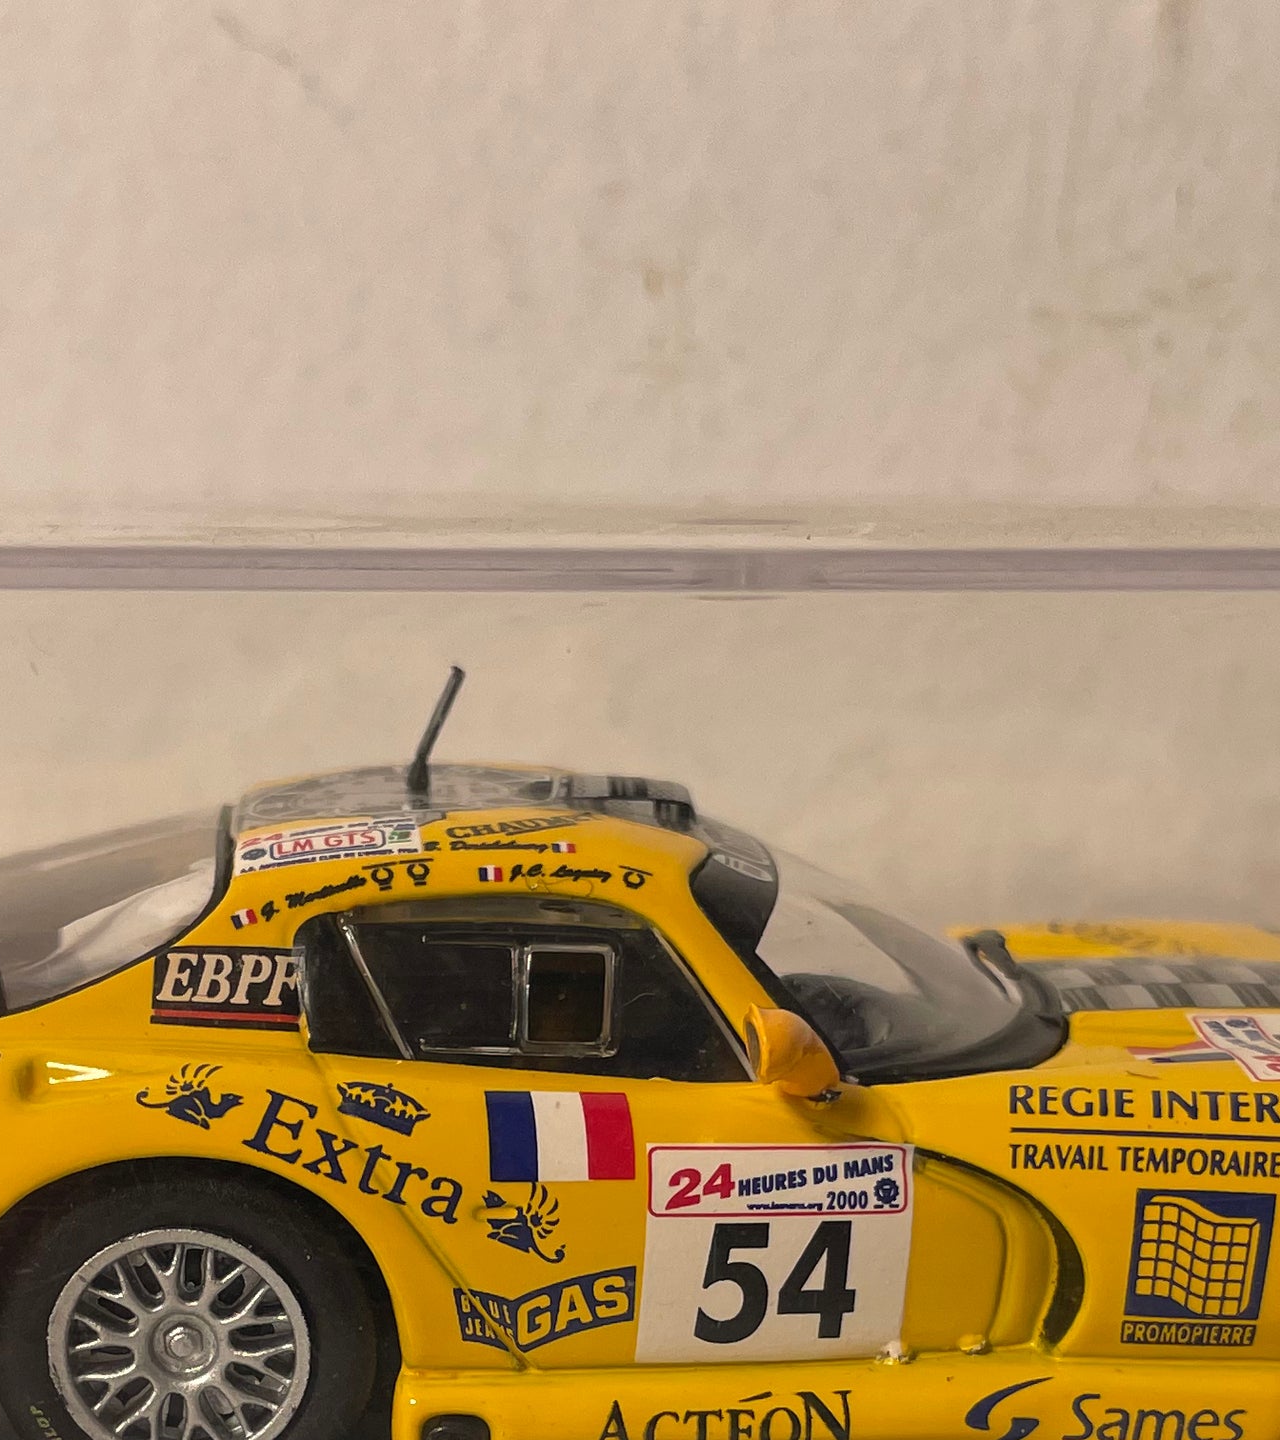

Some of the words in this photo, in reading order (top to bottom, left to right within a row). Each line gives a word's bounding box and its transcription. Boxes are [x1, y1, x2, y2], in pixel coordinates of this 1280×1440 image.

[276, 839, 314, 856] LM
[323, 831, 376, 848] GTS
[1008, 1084, 1135, 1119] REGIE
[241, 1089, 463, 1225] Extra
[1009, 1144, 1109, 1172] TRAVAIL
[665, 1163, 736, 1210] 24
[738, 1169, 808, 1197] HEURES
[813, 1164, 838, 1185] DU
[844, 1154, 894, 1179] MANS
[826, 1191, 868, 1210] 2000
[693, 1220, 856, 1344] 54
[517, 1275, 629, 1346] GAS
[1123, 1321, 1254, 1345] PROMOPIERRE
